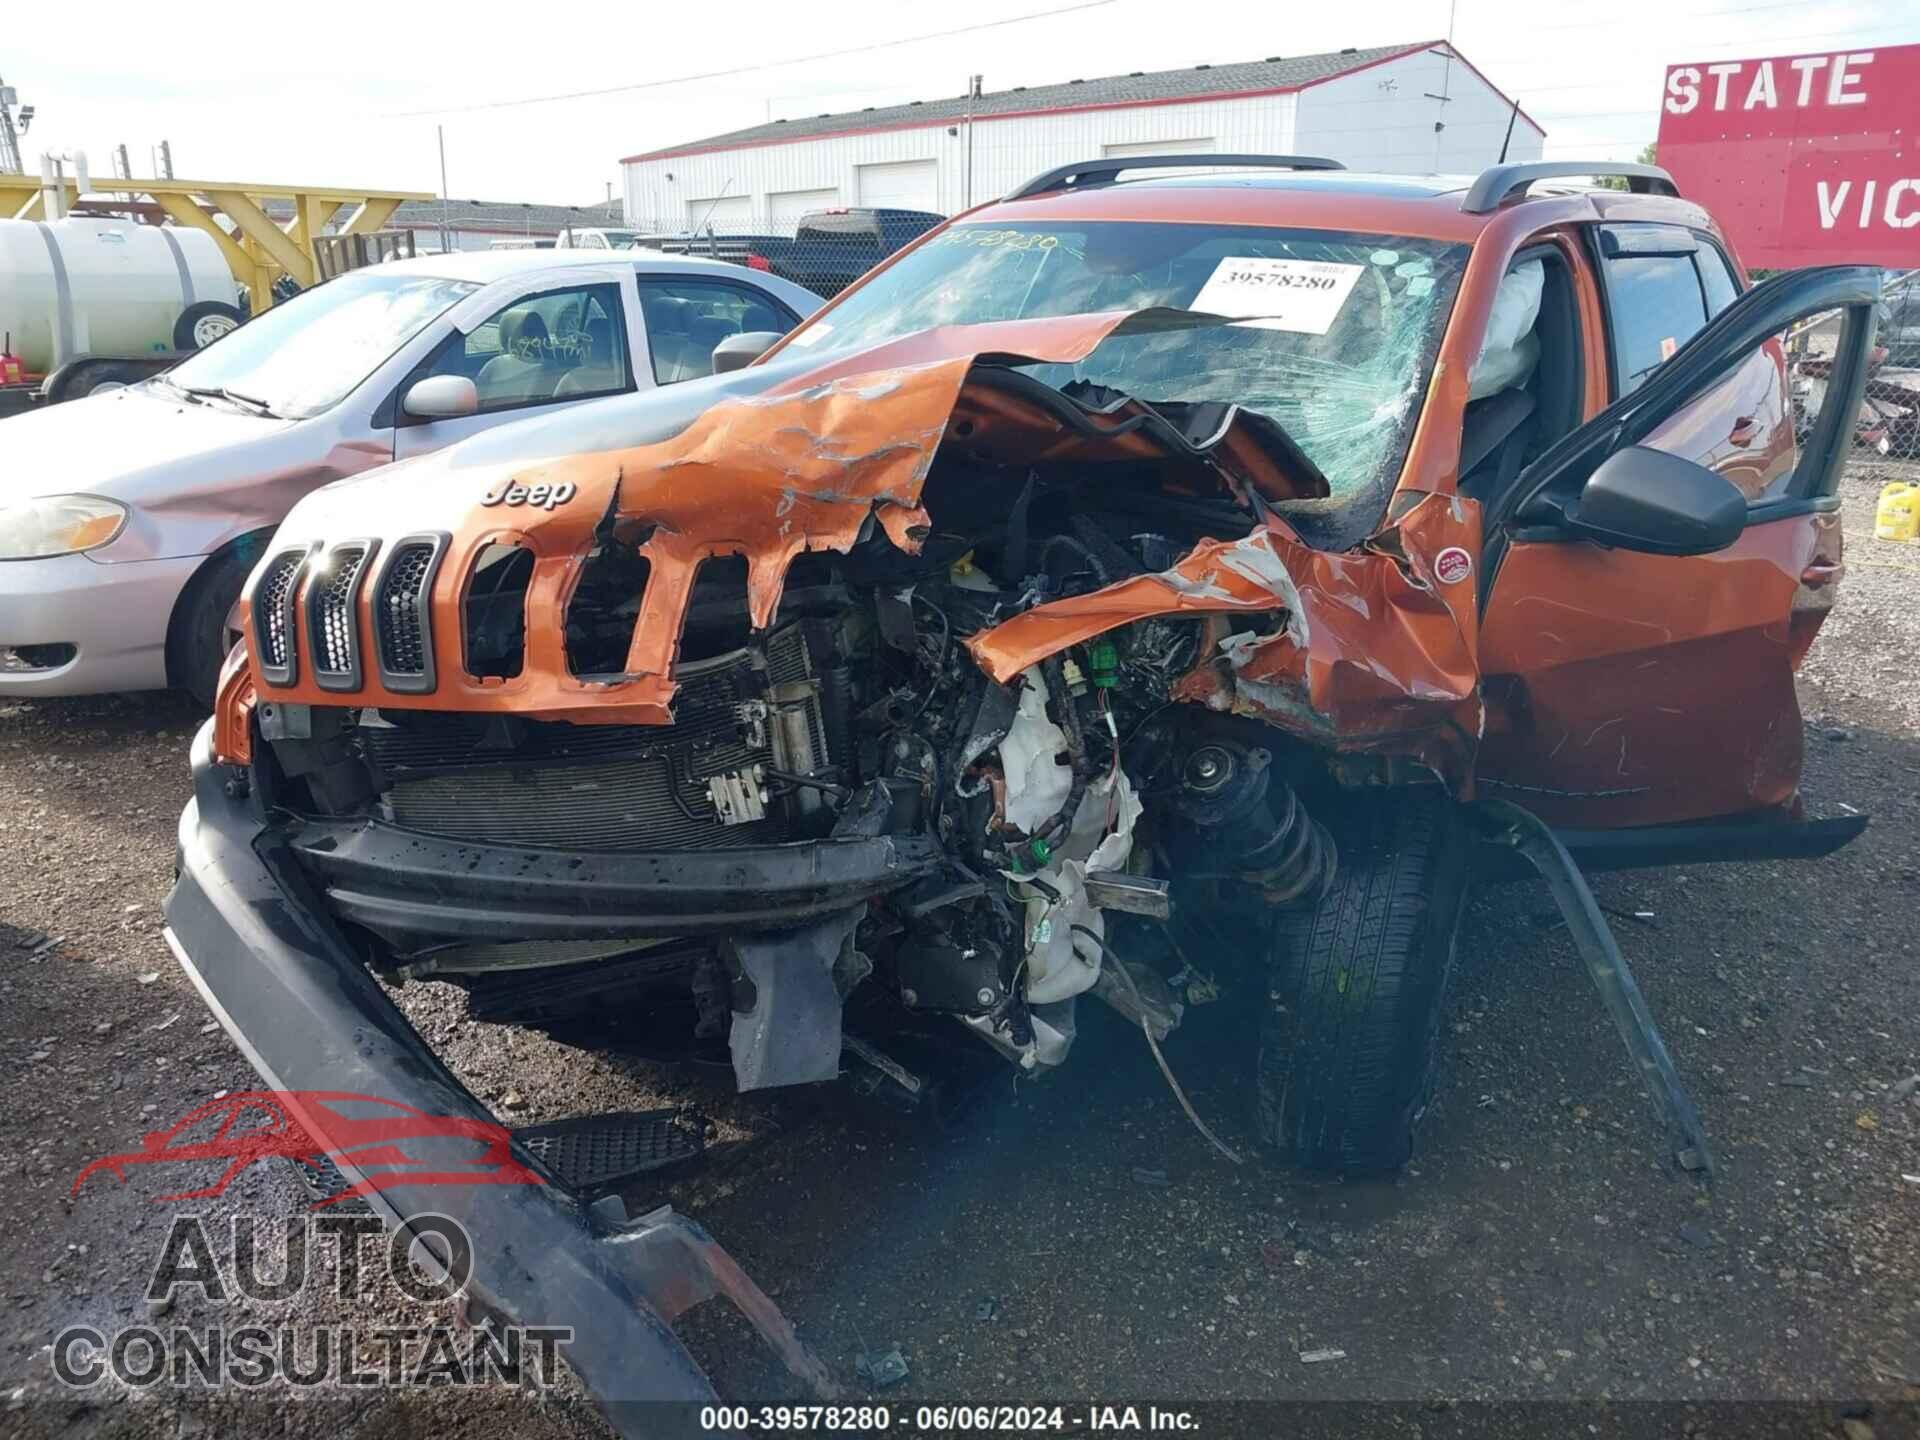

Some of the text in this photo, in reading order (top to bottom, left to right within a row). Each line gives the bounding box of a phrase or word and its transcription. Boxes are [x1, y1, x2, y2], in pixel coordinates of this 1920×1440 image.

[1664, 52, 1875, 115] STATE
[1221, 271, 1337, 292] 39578280
[480, 479, 577, 511] Jeep
